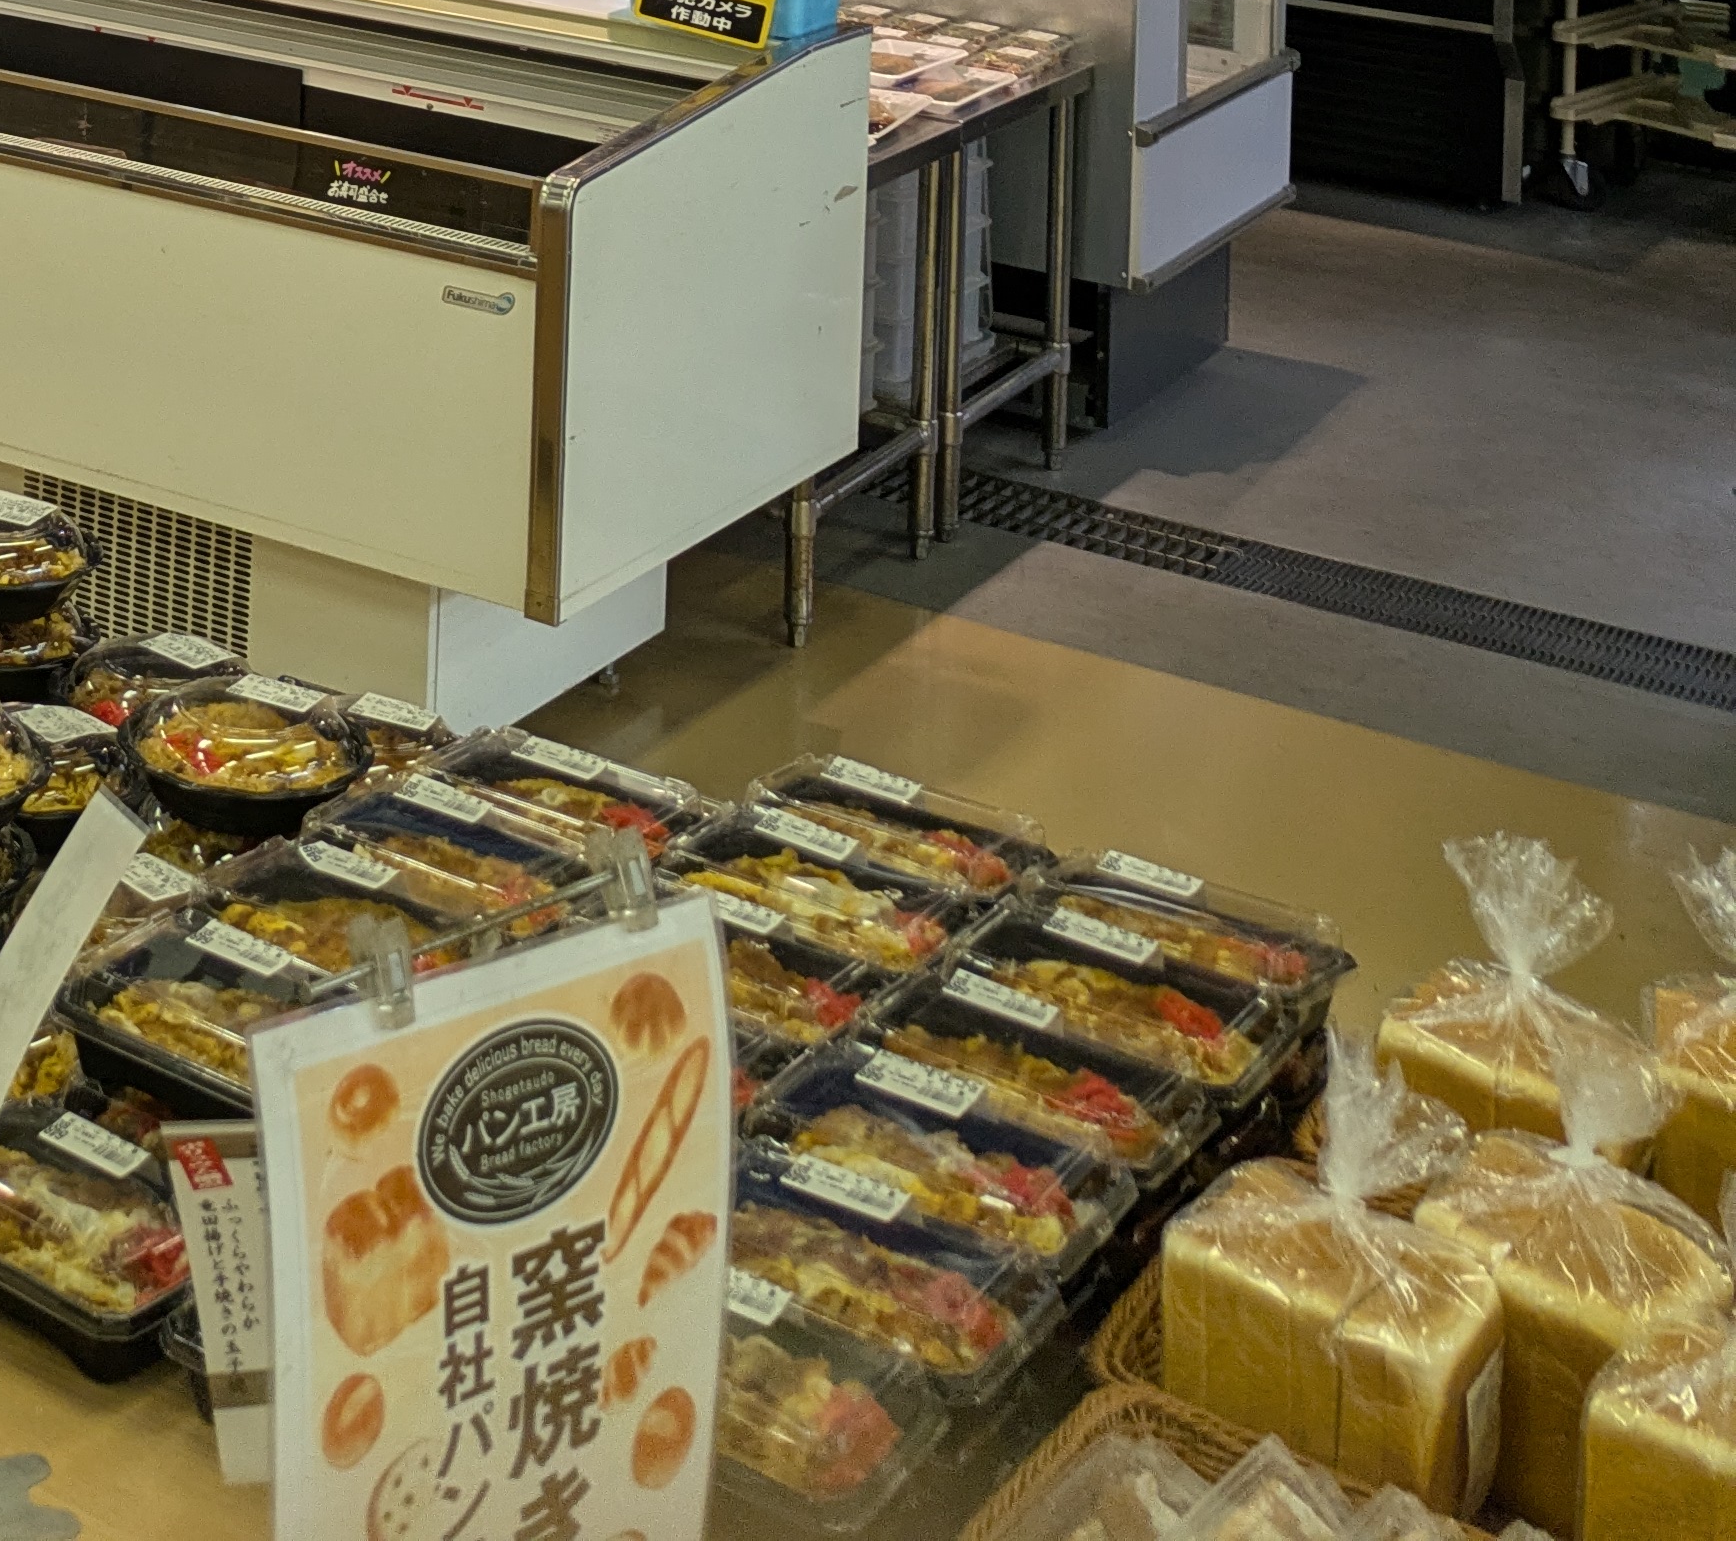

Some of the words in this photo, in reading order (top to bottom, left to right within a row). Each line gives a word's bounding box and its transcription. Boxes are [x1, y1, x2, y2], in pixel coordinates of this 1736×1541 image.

[670, 4, 732, 32] 作動中
[520, 1033, 558, 1057] bread
[559, 1040, 595, 1073] every
[464, 1043, 518, 1089] delicious
[436, 1083, 465, 1129] bake
[589, 1069, 604, 1107] day
[462, 1081, 582, 1154] パン工房
[430, 1132, 446, 1168] We
[519, 1132, 564, 1158] factory
[435, 1264, 495, 1541] 自社パン
